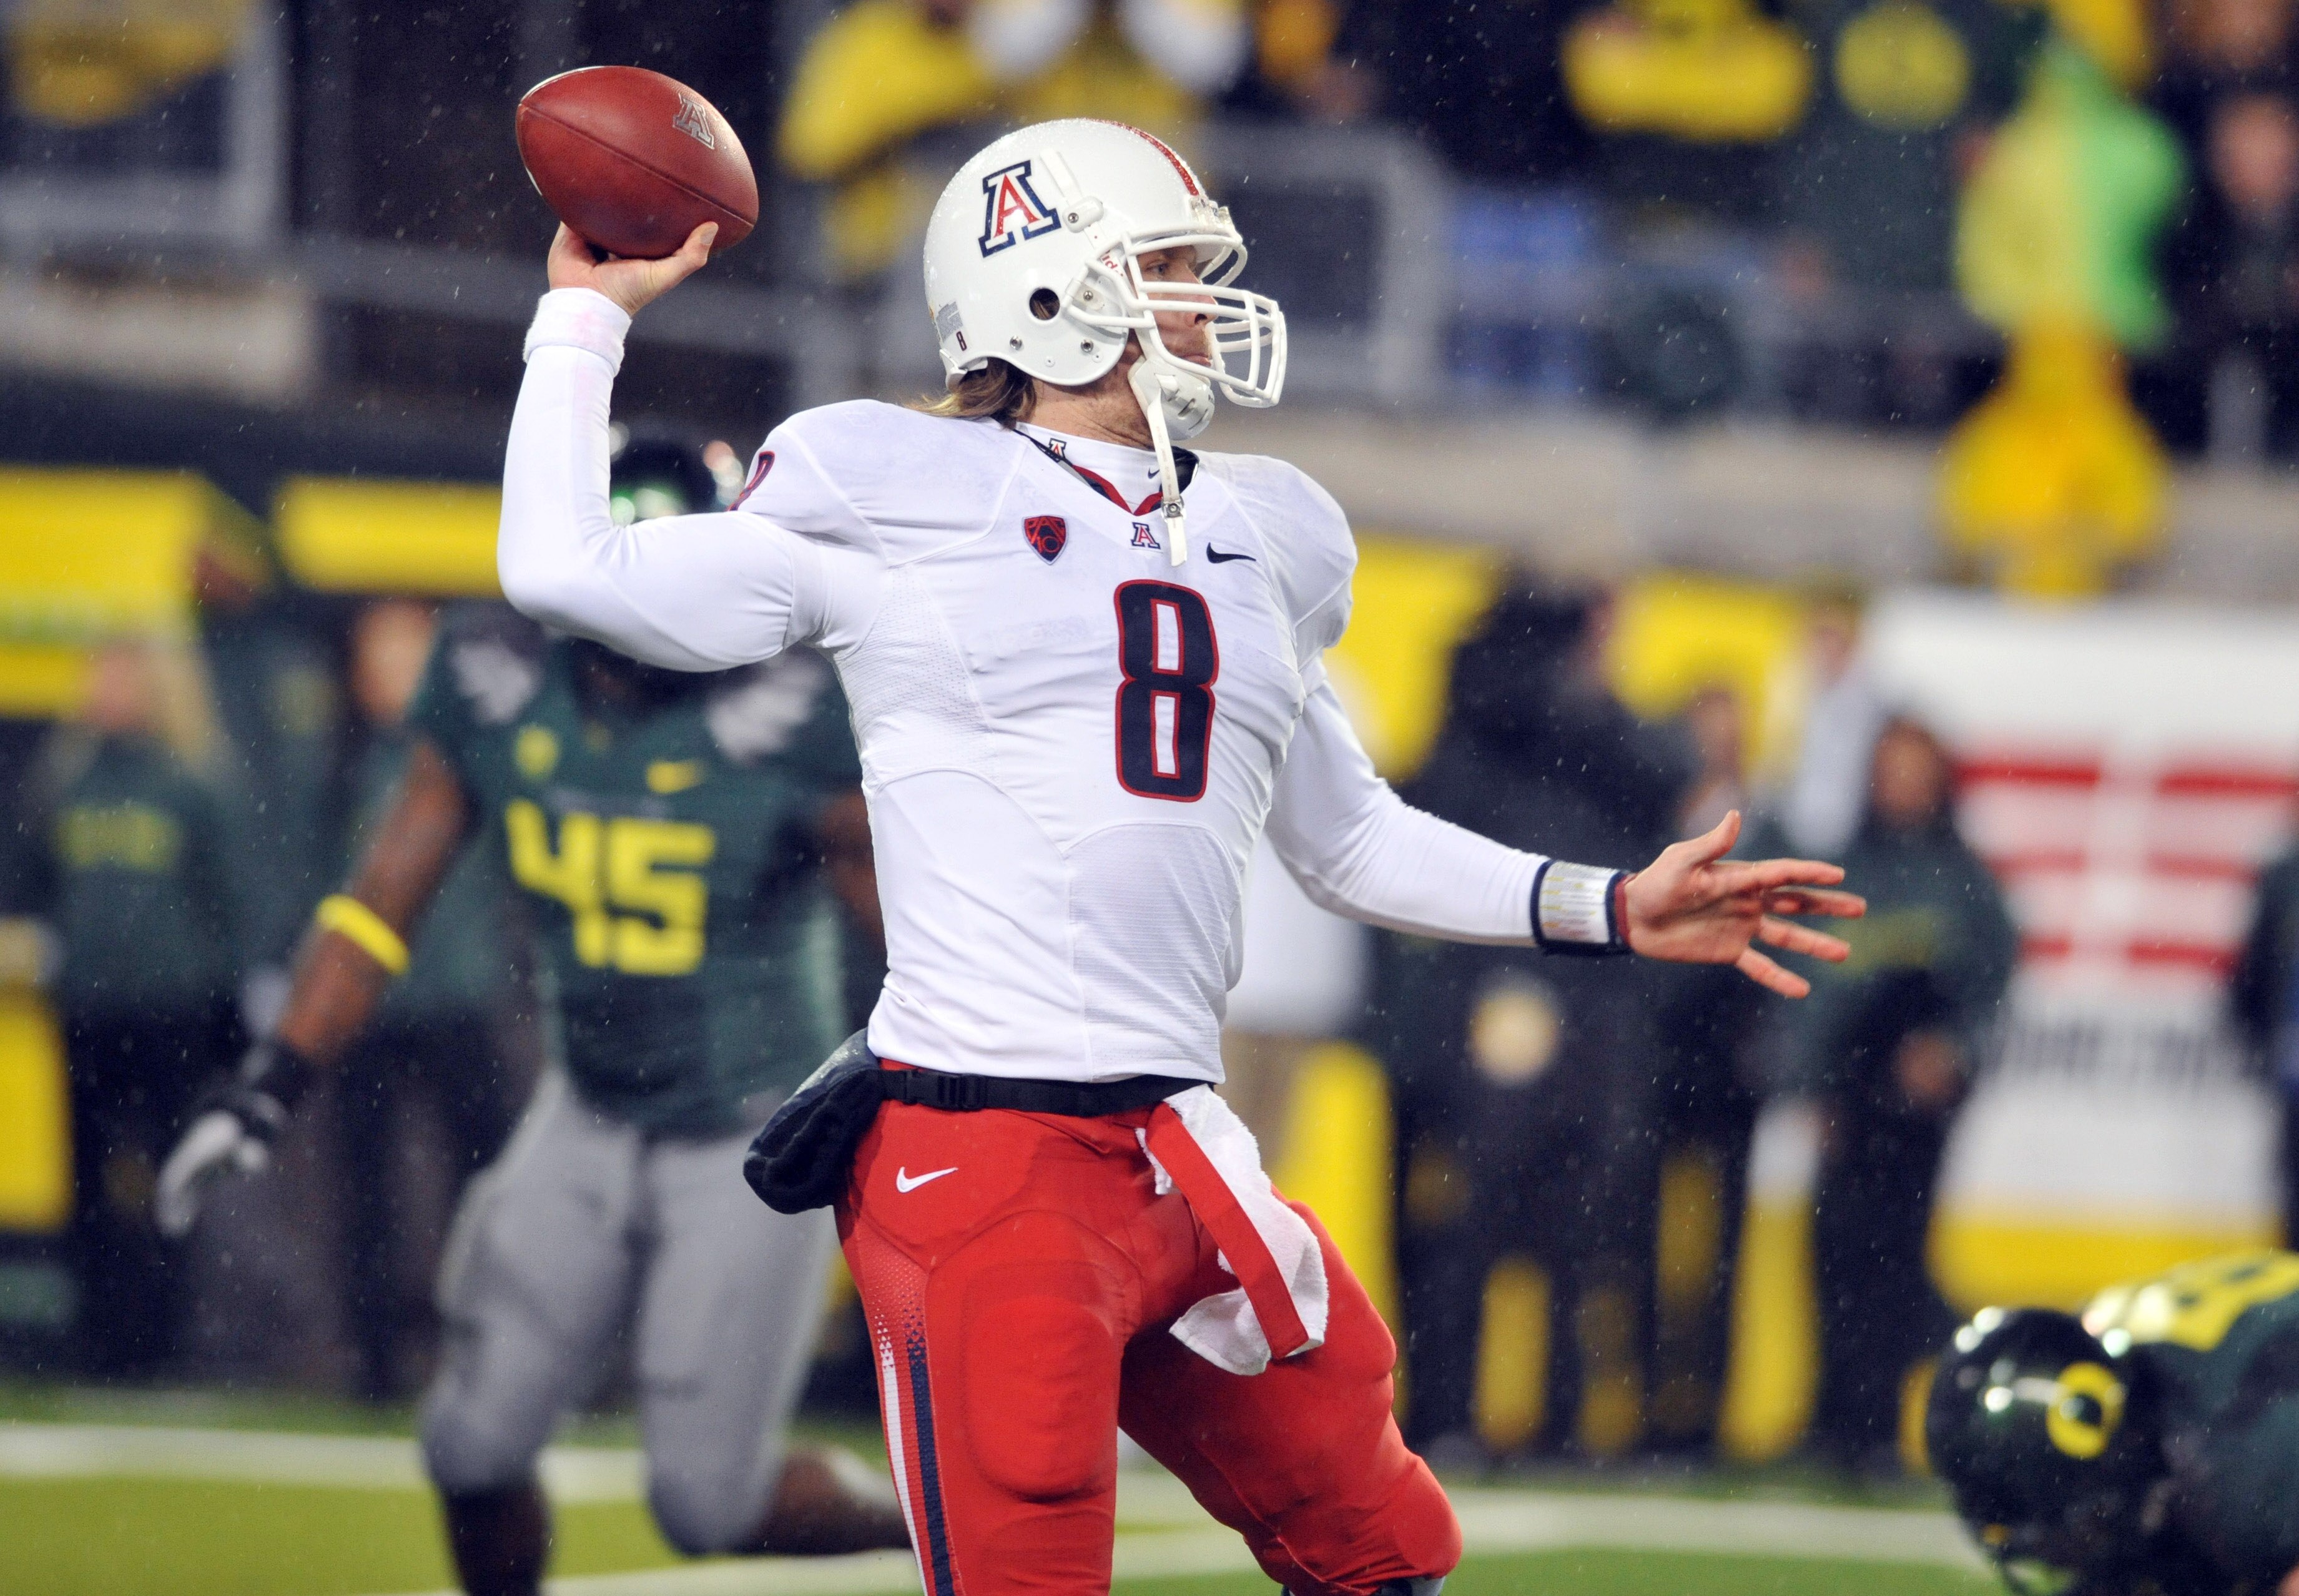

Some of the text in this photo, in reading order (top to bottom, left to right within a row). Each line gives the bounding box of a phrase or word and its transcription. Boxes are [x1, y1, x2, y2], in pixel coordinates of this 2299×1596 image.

[672, 93, 714, 149] A
[978, 159, 1061, 258] A
[956, 331, 967, 351] 8
[1131, 522, 1161, 549] A
[1114, 579, 1219, 802] 8
[505, 796, 717, 976] 45
